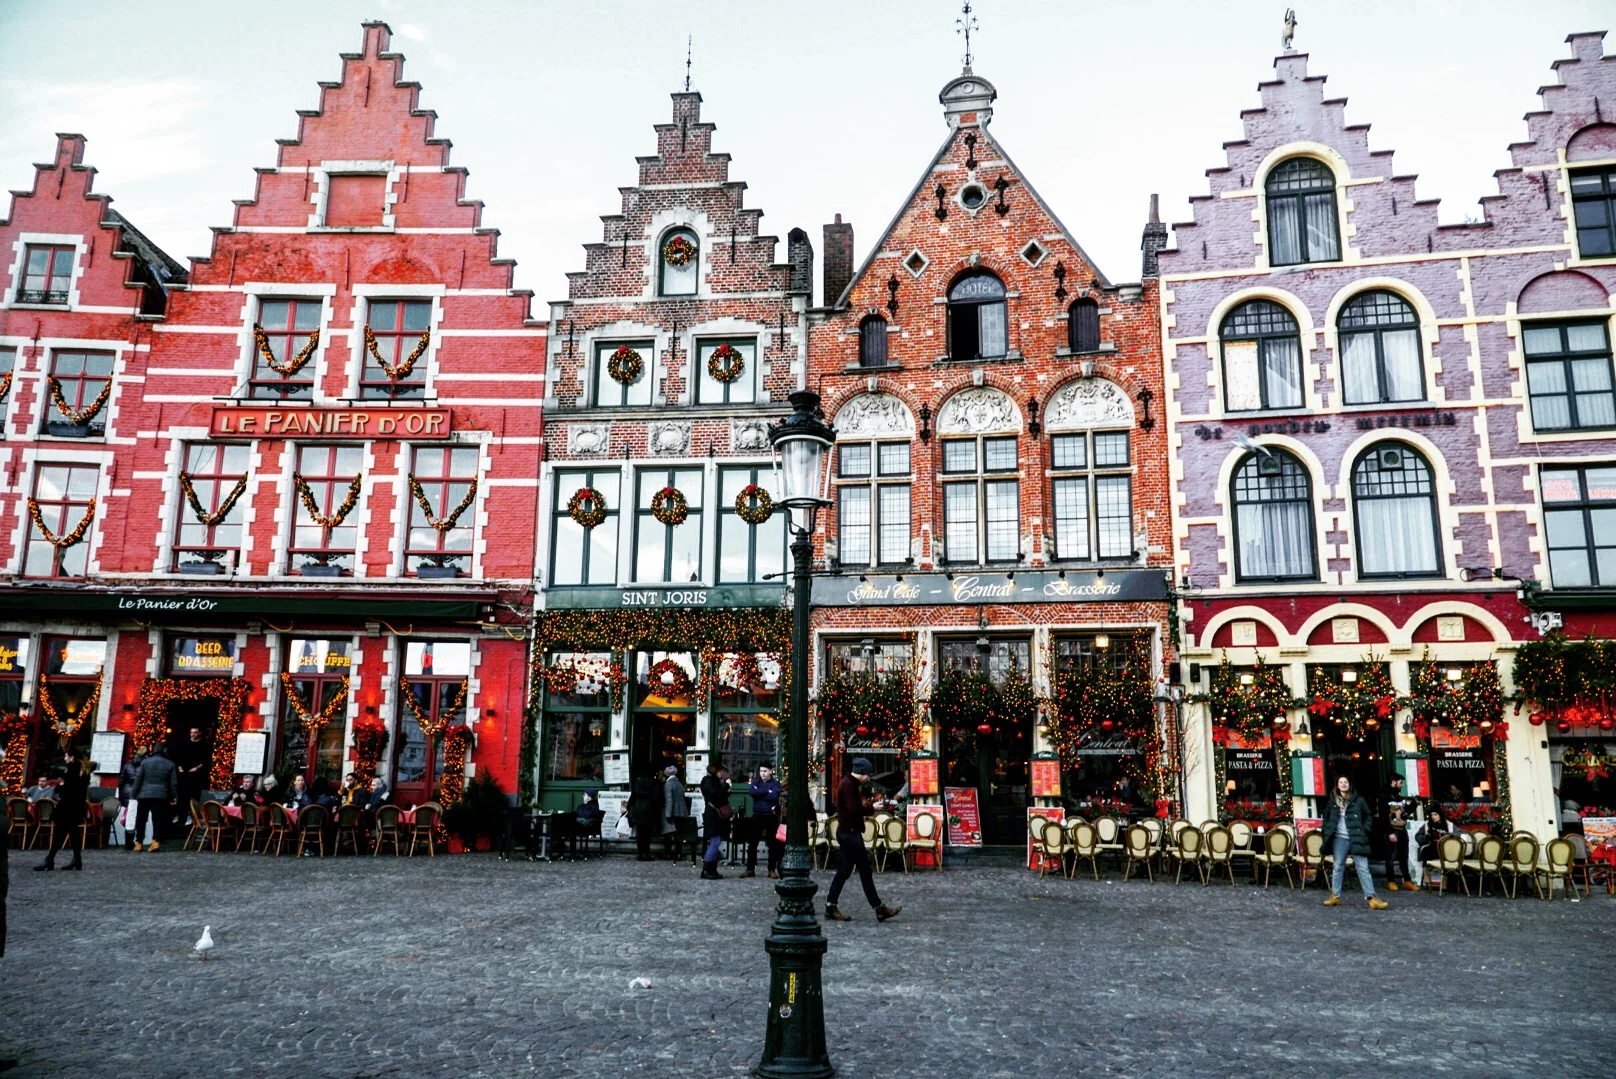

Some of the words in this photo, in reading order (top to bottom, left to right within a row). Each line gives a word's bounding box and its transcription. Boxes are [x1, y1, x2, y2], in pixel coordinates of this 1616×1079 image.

[962, 282, 994, 295] HOTEL
[220, 416, 257, 433] LE
[263, 411, 370, 434] PANIER
[377, 413, 445, 434] D'OR
[846, 584, 891, 604] Grand
[952, 576, 1012, 602] Central
[1043, 580, 1121, 597] Brasserie
[118, 597, 136, 609] Le
[136, 598, 184, 609] Panier
[185, 598, 218, 610] d'Or
[621, 591, 658, 605] SINT
[662, 591, 707, 605] JORIS
[195, 642, 222, 655] BEER
[178, 655, 234, 668] BRASSERIE
[1433, 729, 1480, 748] Pizza
[1228, 761, 1248, 769] PASTA
[1248, 761, 1253, 769] &
[1254, 761, 1273, 769] PIZZA
[1436, 760, 1458, 768] PASTA
[1458, 760, 1464, 768] &
[1464, 760, 1485, 768] PIZZA
